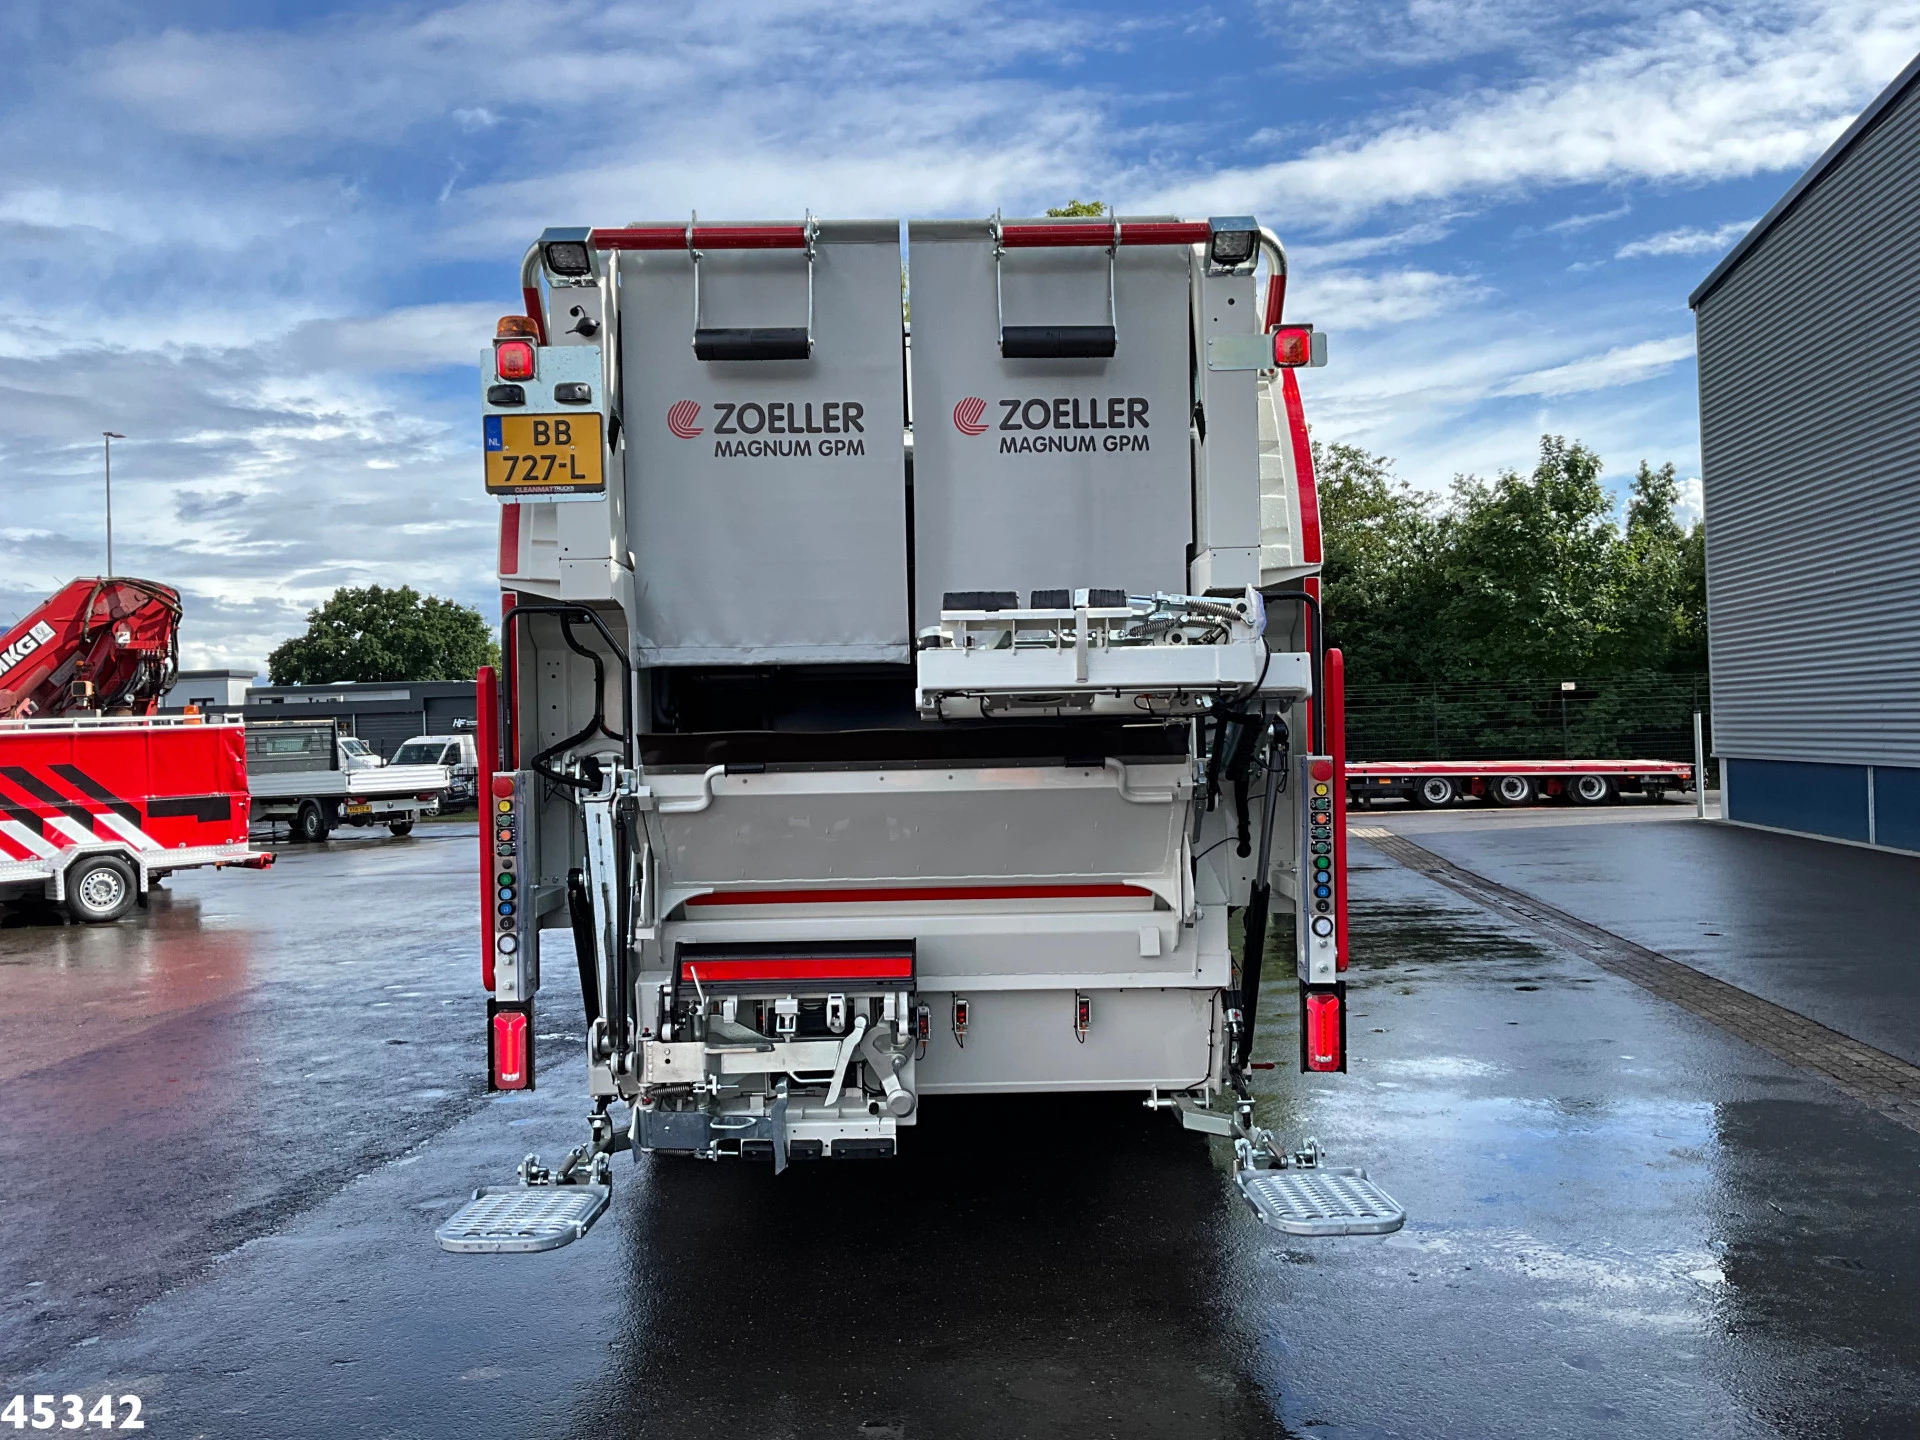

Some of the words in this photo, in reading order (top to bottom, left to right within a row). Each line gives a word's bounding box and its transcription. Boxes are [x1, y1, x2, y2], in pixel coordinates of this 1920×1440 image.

[713, 402, 865, 434] ZOELLER
[999, 397, 1150, 430] ZOELLER
[488, 438, 500, 446] NL
[533, 420, 572, 446] BB
[999, 435, 1097, 454] MAGNUM
[1102, 435, 1150, 452] GPM
[714, 440, 812, 457] MAGNUM
[818, 439, 865, 456] GPM
[502, 454, 586, 482] 727-L
